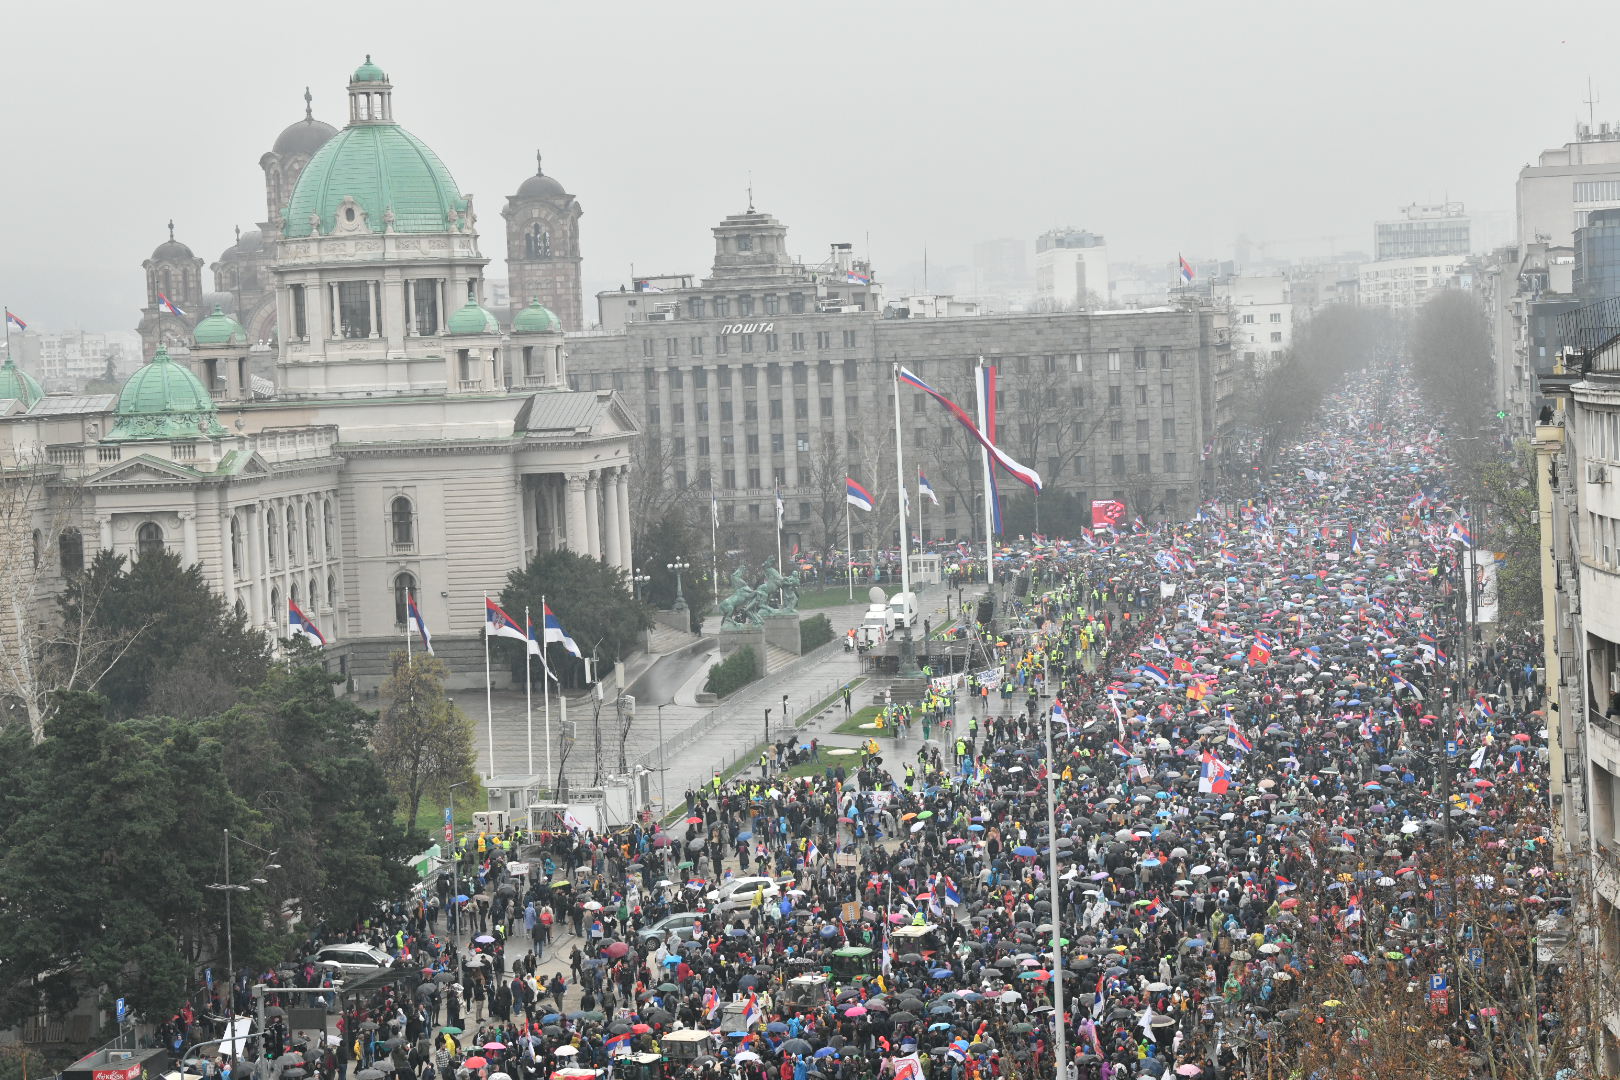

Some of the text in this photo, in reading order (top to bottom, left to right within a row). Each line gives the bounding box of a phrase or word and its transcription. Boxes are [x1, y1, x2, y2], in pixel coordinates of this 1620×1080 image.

[721, 322, 774, 334] ПОШТА
[1433, 976, 1442, 988] P
[118, 1001, 122, 1012] P
